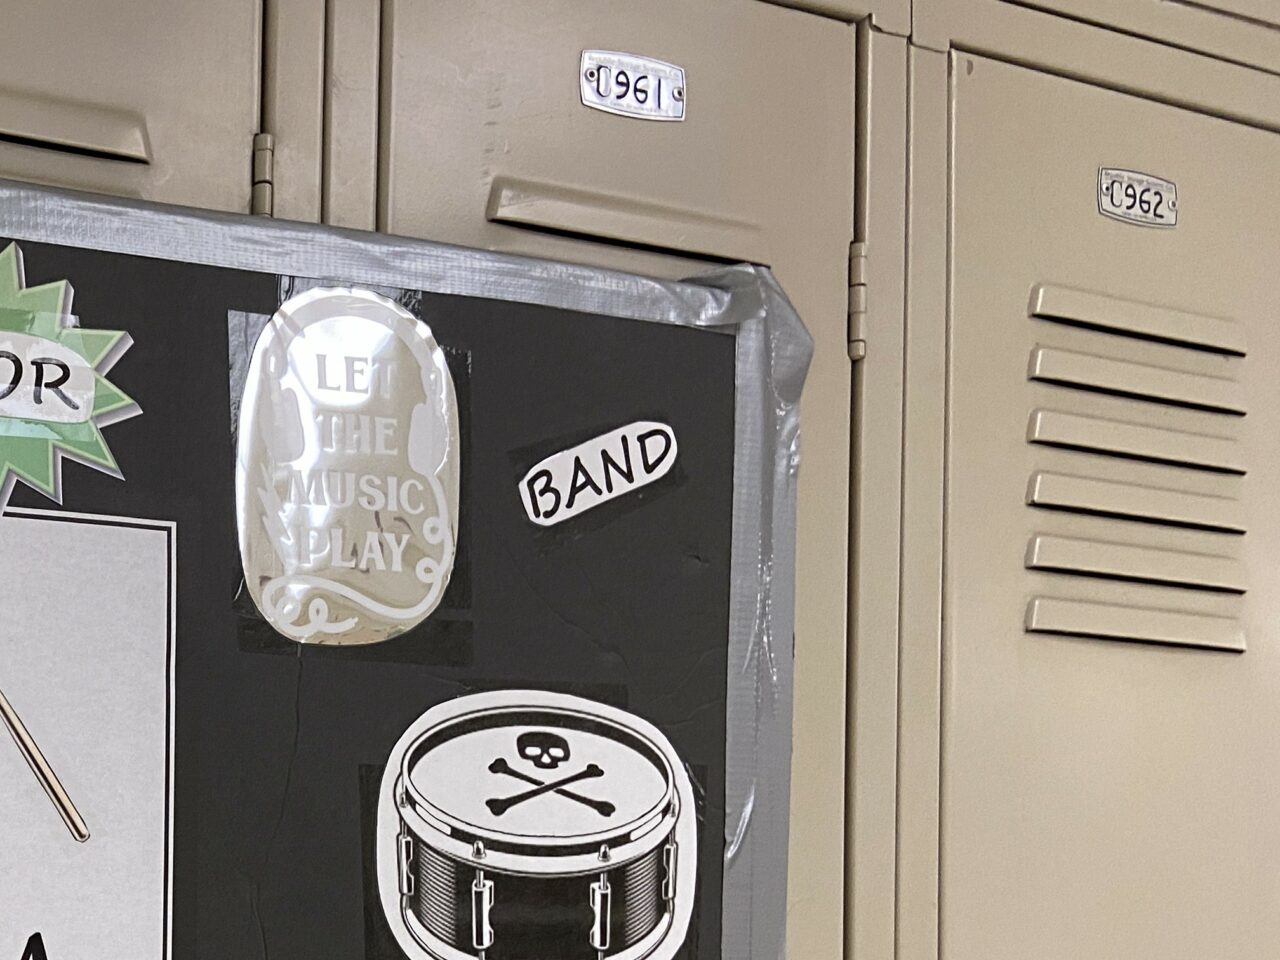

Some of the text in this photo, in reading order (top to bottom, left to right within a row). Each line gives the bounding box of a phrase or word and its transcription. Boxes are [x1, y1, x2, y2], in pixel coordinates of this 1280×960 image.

[1110, 180, 1164, 219] C962
[315, 353, 397, 400] LET
[315, 412, 399, 456] THE
[286, 468, 426, 516] MUSIC
[526, 429, 672, 519] BAND
[298, 526, 411, 573] PLAY
